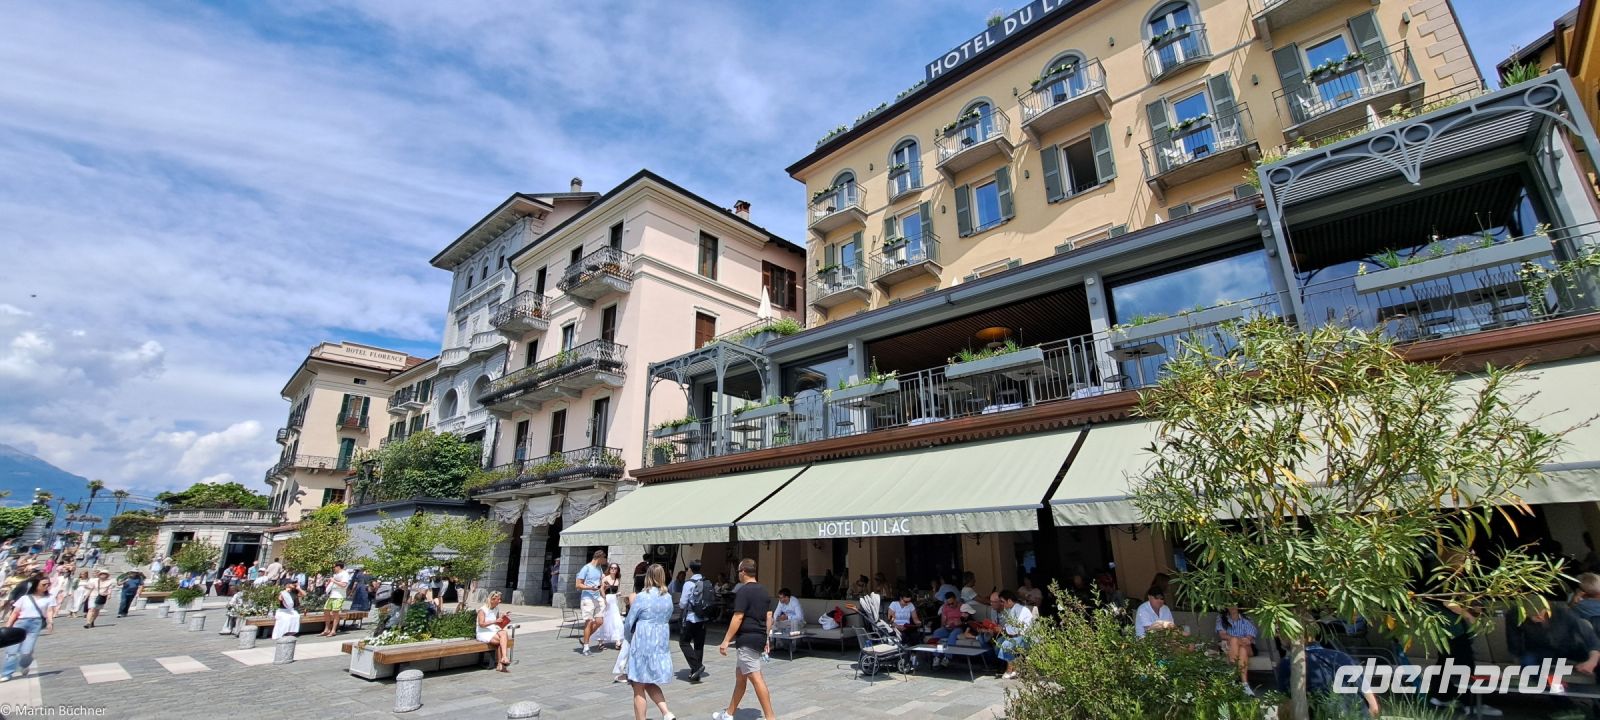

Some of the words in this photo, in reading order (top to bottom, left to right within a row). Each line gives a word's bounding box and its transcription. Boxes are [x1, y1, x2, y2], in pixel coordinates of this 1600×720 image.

[930, 32, 996, 78] HOTEL
[1003, 8, 1033, 36] DU
[345, 346, 367, 357] HOTEL
[369, 350, 404, 362] FLORENCE
[818, 520, 857, 537] HOTEL
[861, 519, 879, 535] DU
[883, 518, 911, 534] LAC
